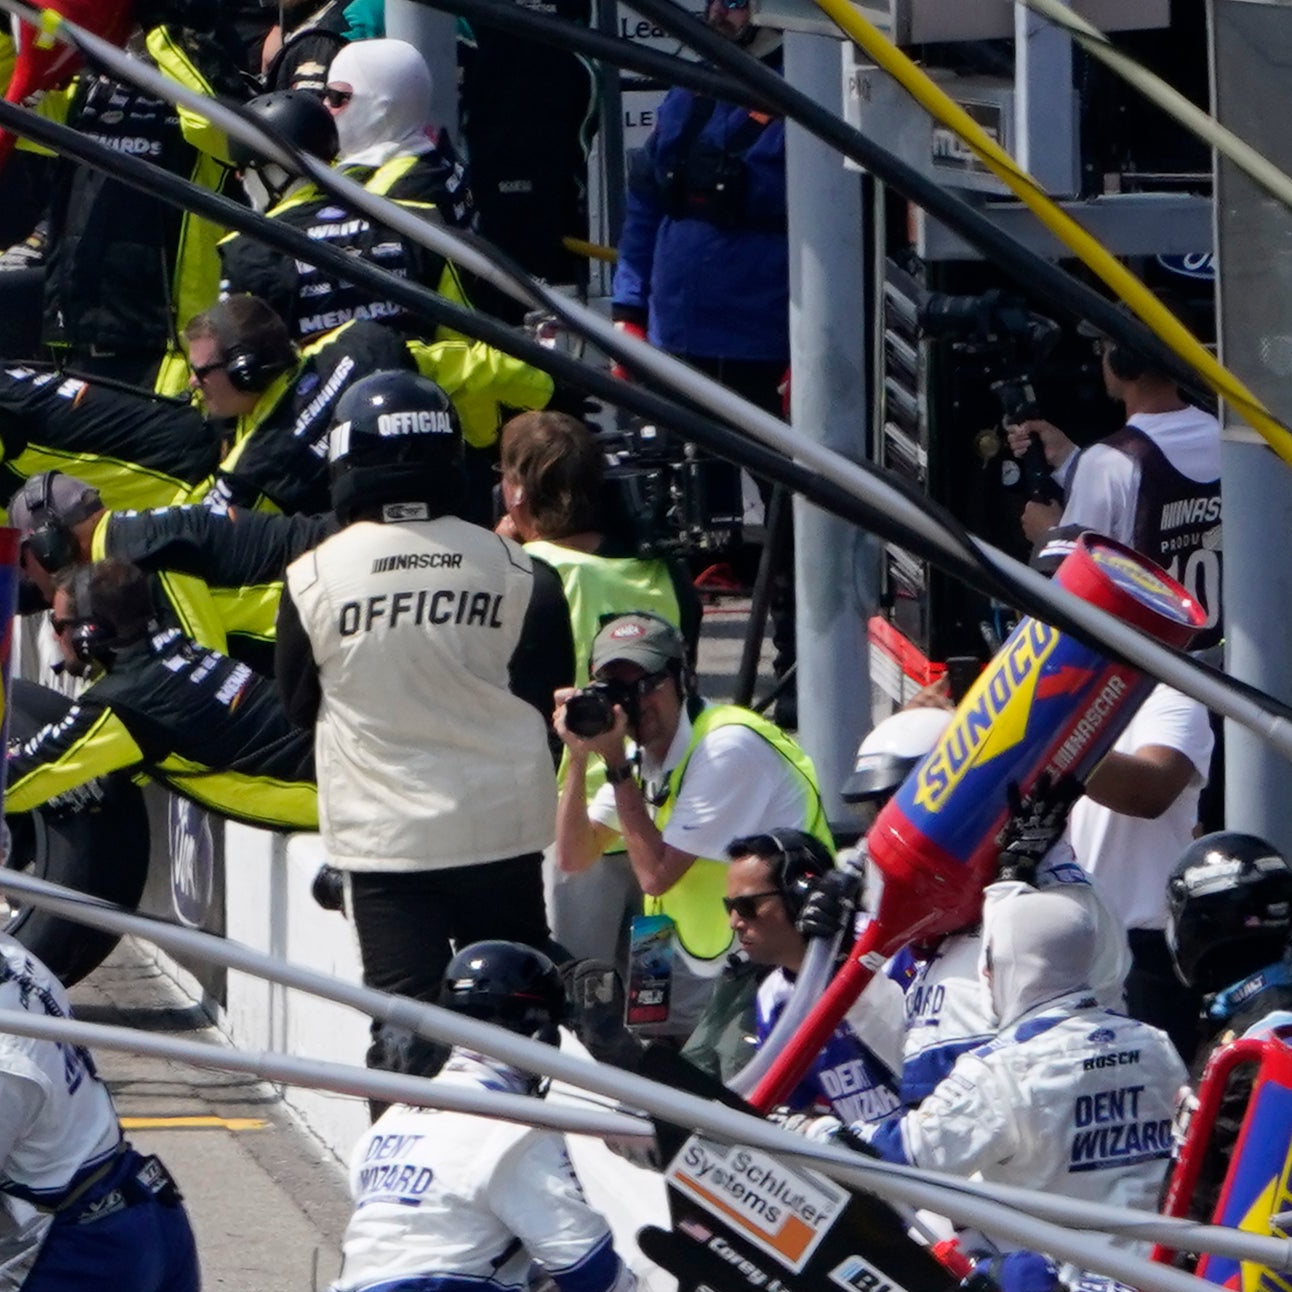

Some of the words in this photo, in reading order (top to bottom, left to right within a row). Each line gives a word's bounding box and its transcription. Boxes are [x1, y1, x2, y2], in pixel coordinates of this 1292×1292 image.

[294, 355, 355, 436] JENNINGS
[378, 411, 453, 437] OFFICIAL
[398, 553, 464, 570] NASCAR
[339, 590, 504, 638] OFFICIAL
[923, 628, 1059, 800] SUNOCO
[1075, 1085, 1145, 1128] DENT
[365, 1134, 426, 1163] DENT
[360, 1164, 434, 1195] WIZARD
[684, 1144, 782, 1224] Systems
[709, 1238, 768, 1287] Corey
